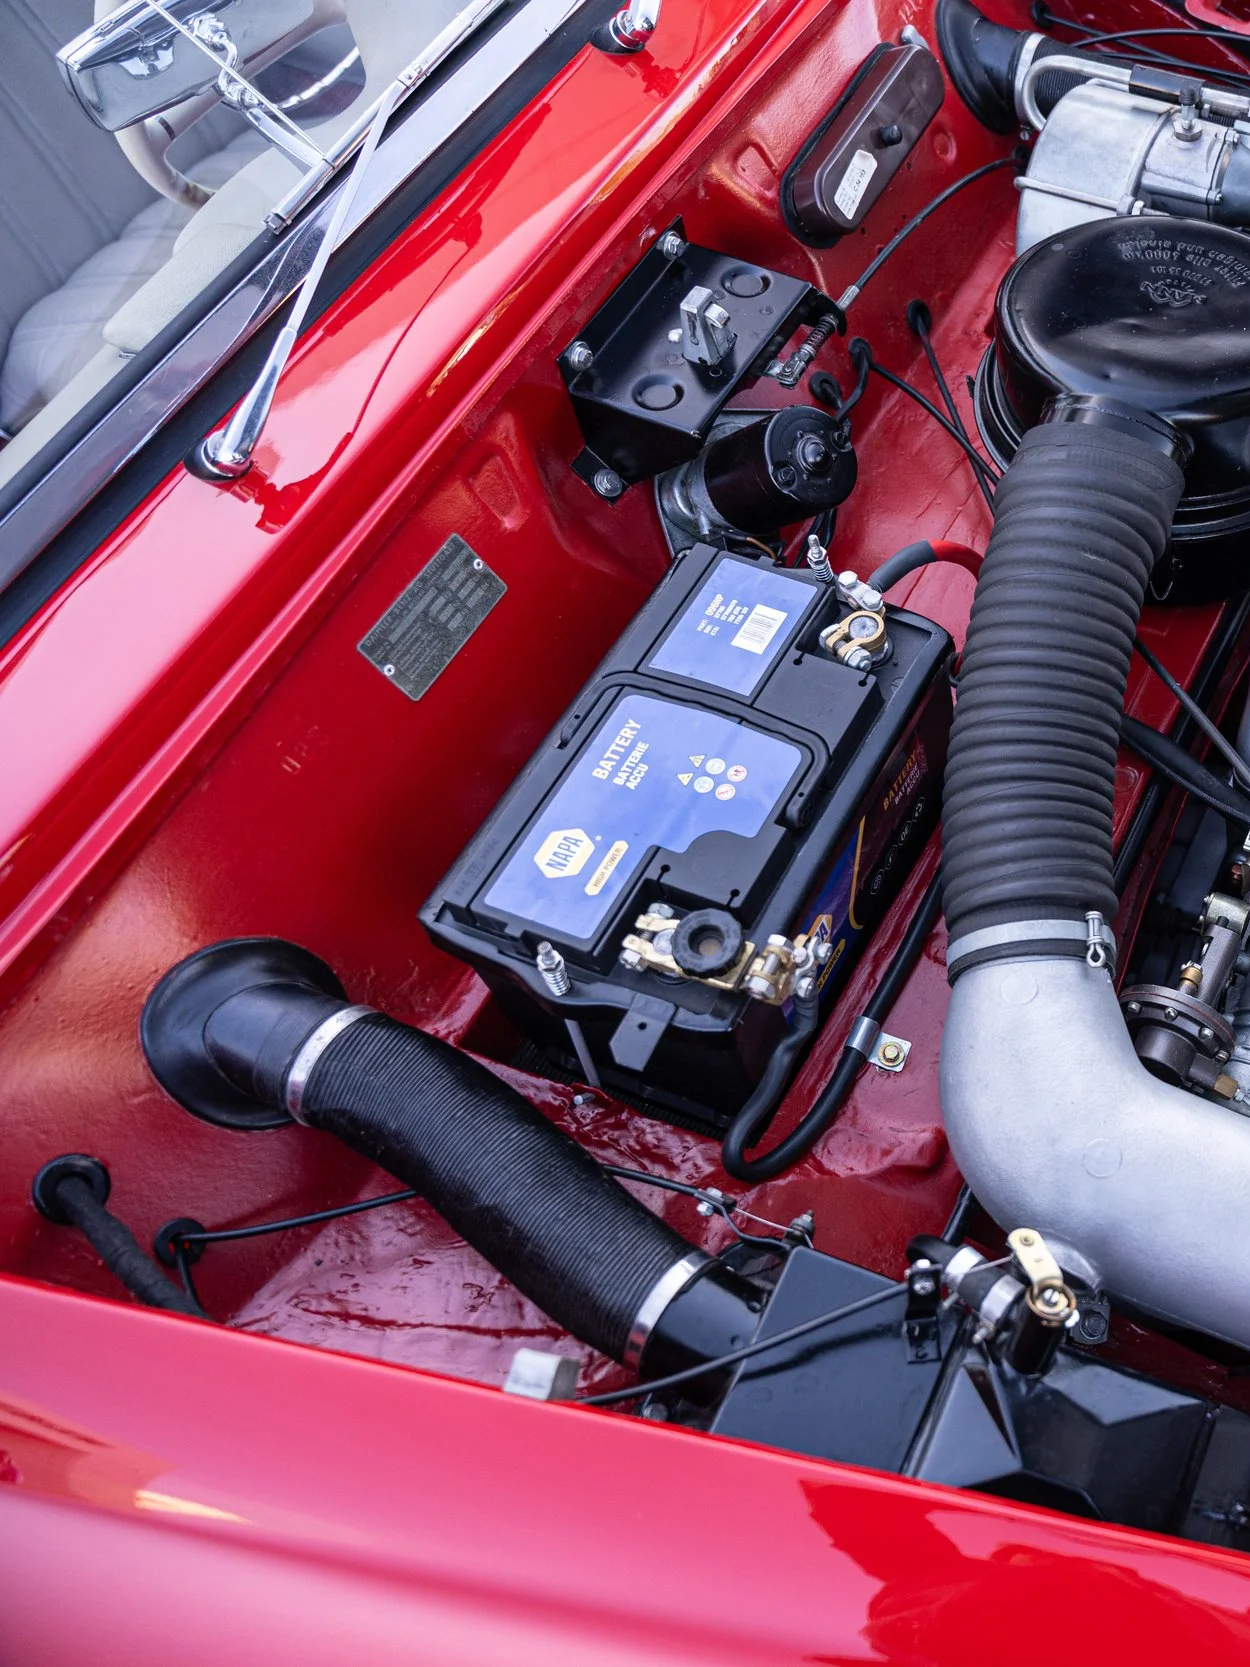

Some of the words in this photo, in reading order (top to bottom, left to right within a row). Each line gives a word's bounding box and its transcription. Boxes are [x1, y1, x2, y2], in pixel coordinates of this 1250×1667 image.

[1177, 241, 1205, 254] und
[1185, 253, 1212, 267] alle
[1214, 264, 1248, 288] Filter
[591, 718, 642, 780] BATTERY
[612, 741, 650, 786] BATTERIE
[624, 764, 650, 791] ACCU
[883, 749, 917, 811] BATTERY
[894, 762, 919, 805] BATTERIE
[906, 769, 920, 796] ACCU
[545, 835, 584, 872] NAPA
[593, 871, 607, 888] HIGH
[603, 847, 623, 874] POWER
[822, 948, 841, 980] POWER
